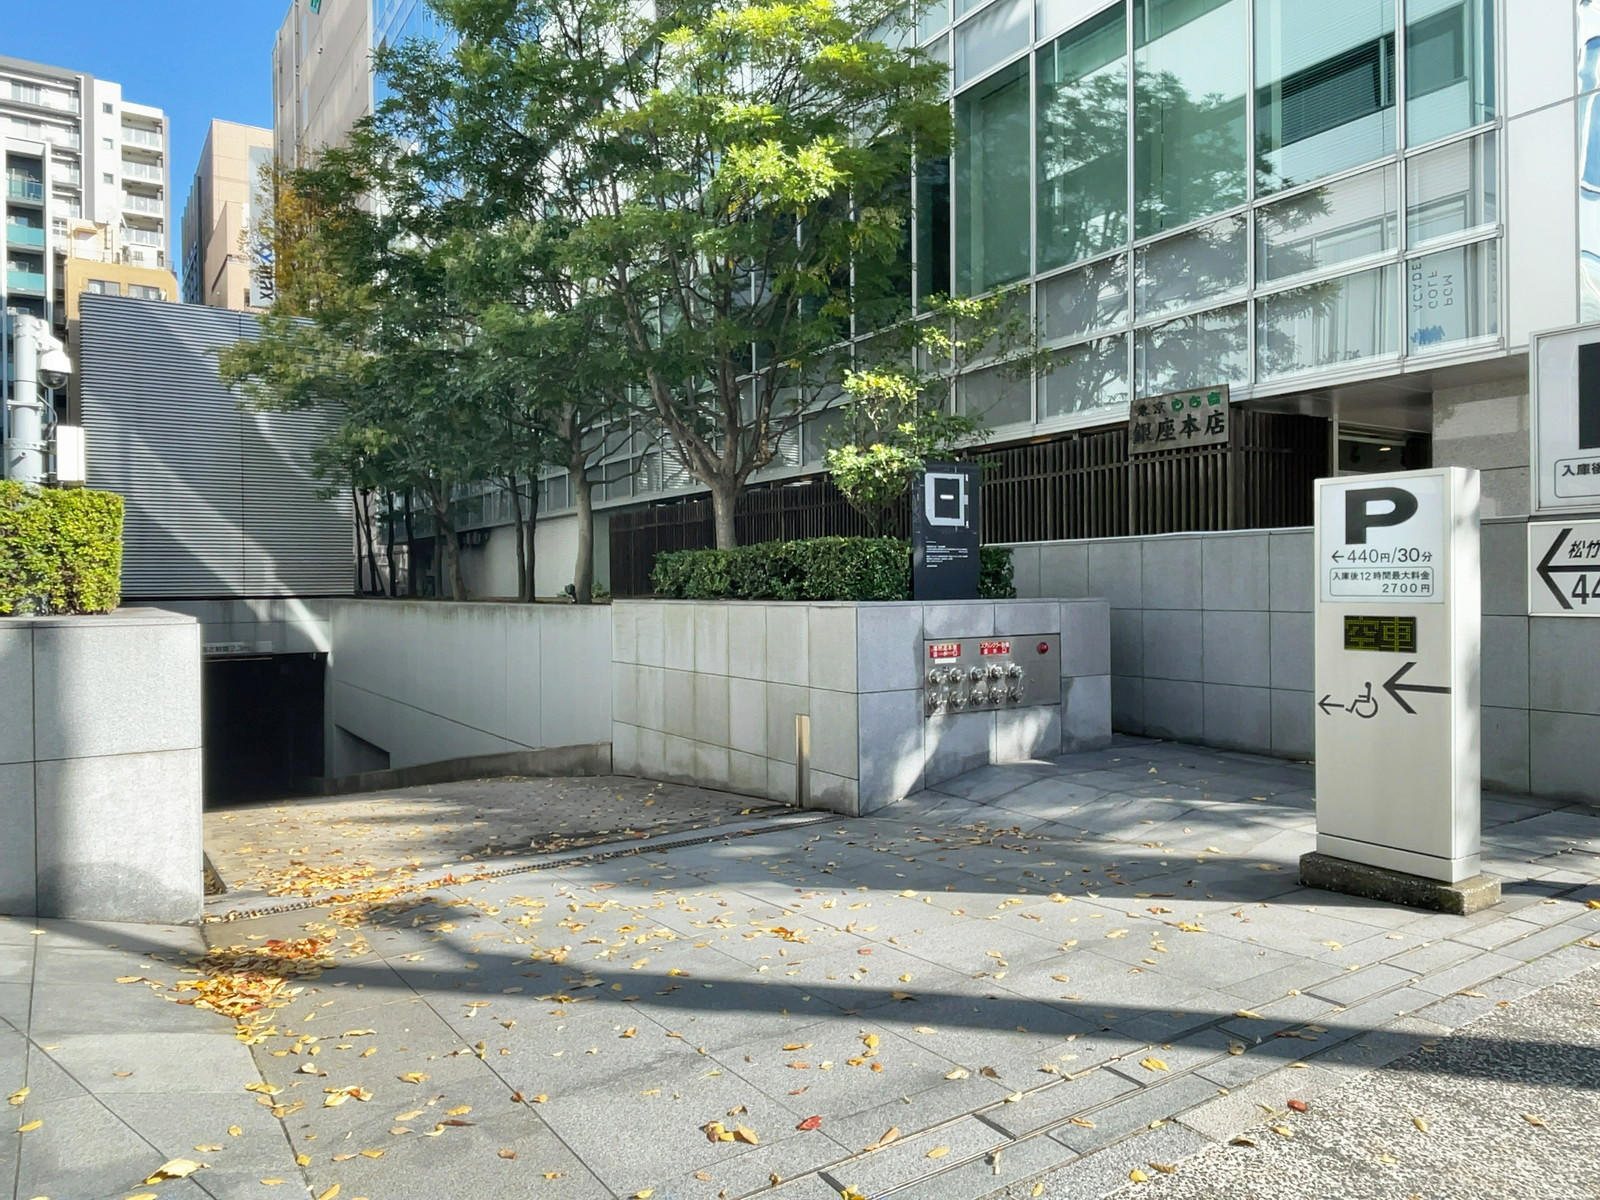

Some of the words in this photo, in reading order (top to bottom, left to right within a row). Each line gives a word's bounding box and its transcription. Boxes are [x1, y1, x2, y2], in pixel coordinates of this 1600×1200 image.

[1132, 410, 1225, 444] 銀座本店
[1345, 487, 1418, 544] P
[1382, 583, 1430, 594] 2700円
[1345, 616, 1413, 651] 空車
